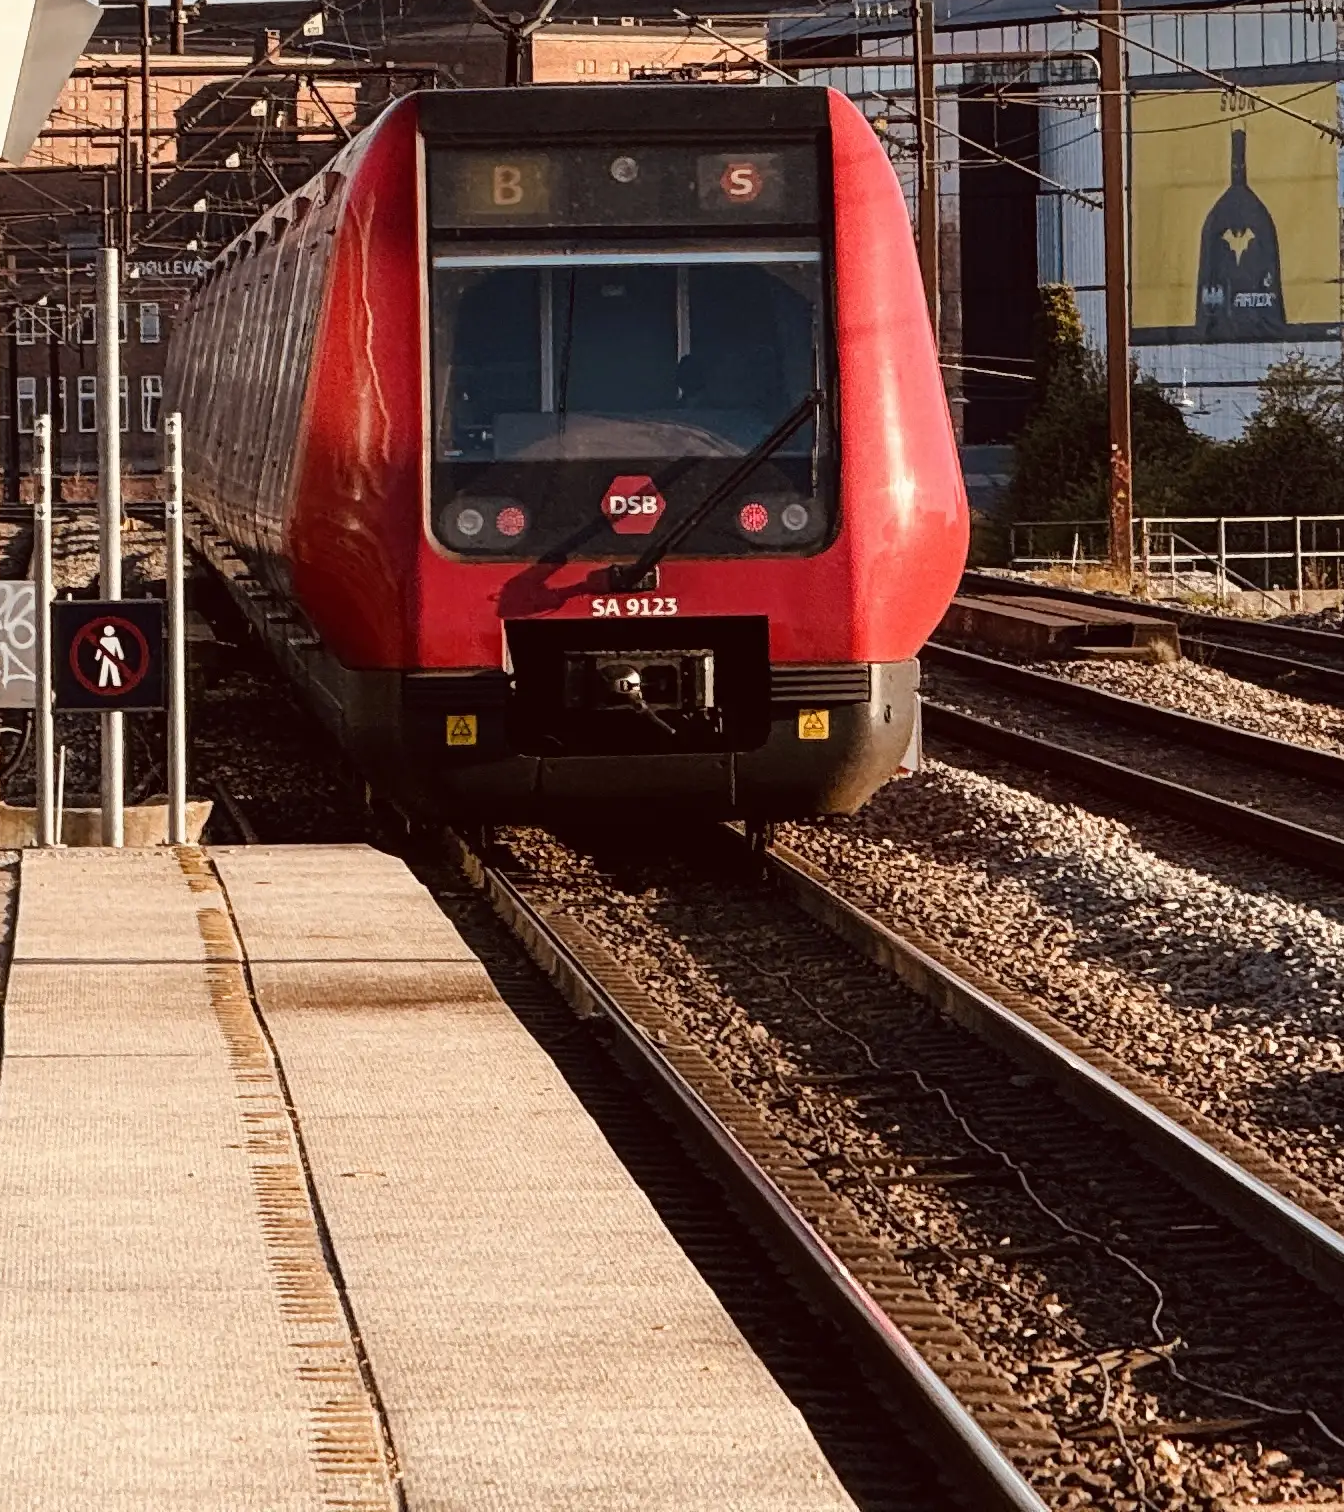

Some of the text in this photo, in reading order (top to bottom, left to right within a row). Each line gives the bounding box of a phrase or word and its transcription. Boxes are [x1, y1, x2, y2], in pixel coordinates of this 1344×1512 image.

[494, 165, 523, 205] B
[730, 169, 753, 196] S
[609, 495, 657, 515] DSB
[592, 597, 678, 617] SA 9123
